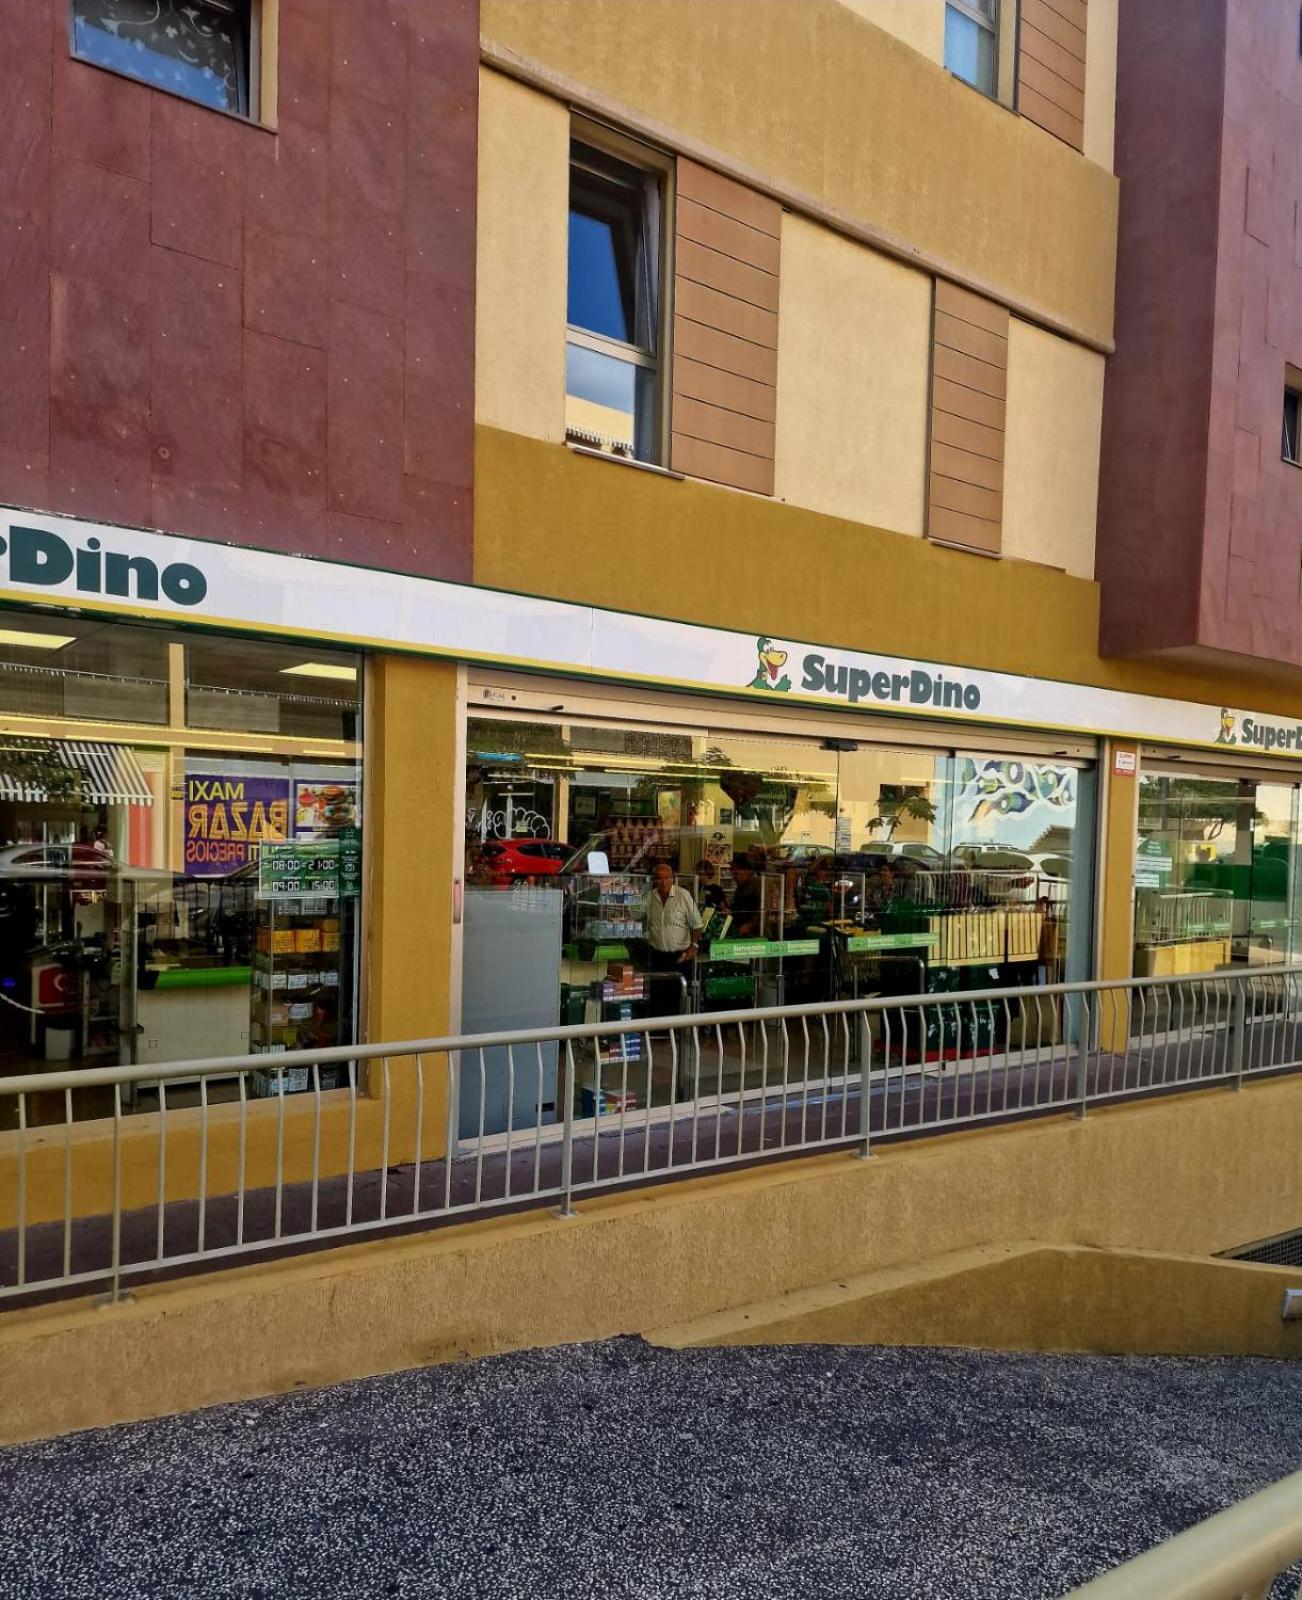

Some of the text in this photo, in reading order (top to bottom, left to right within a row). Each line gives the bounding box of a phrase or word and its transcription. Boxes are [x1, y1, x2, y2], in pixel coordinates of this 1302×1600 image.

[0, 525, 207, 605] Dino
[801, 653, 981, 711] SuperDino
[272, 860, 335, 871] 08:00 21:00
[272, 881, 300, 893] 09:00
